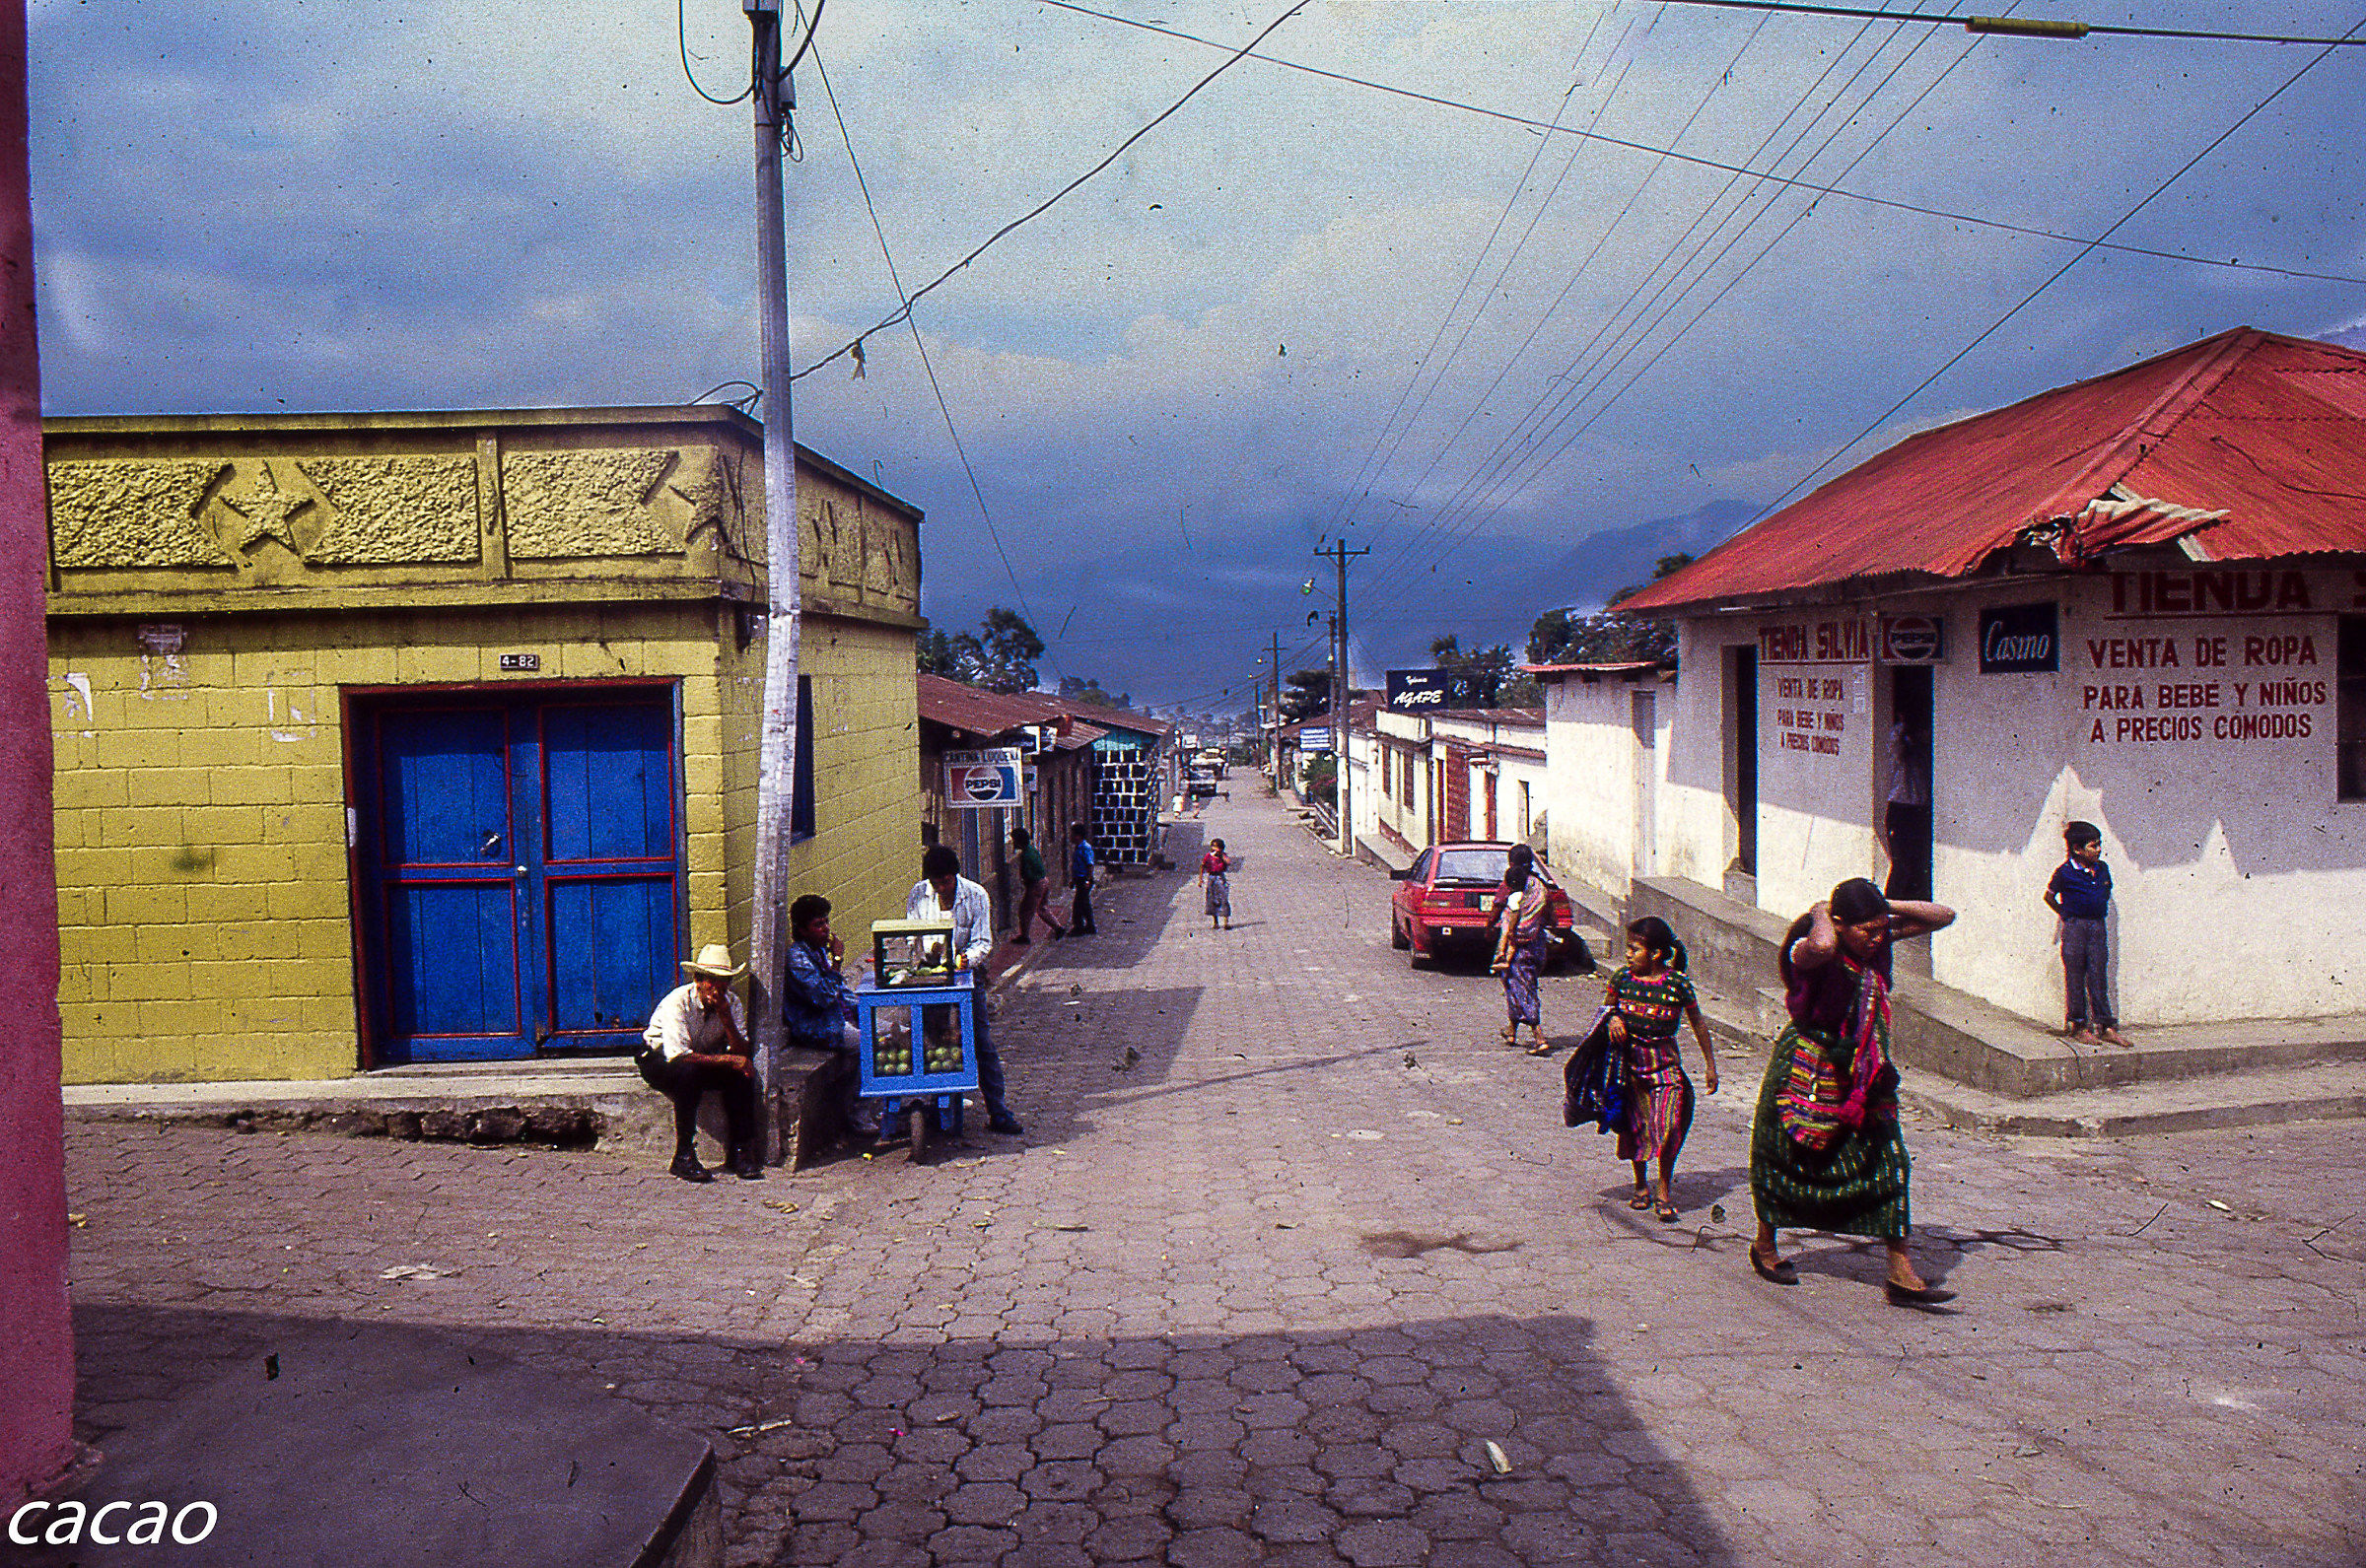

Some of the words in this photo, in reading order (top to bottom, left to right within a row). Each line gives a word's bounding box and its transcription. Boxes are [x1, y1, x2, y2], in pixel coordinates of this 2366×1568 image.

[1815, 620, 1869, 659] SILVIA
[2087, 638, 2180, 668] VENTA
[2194, 637, 2227, 667] DE
[2244, 636, 2317, 666] ROPA
[502, 655, 534, 667] 4-82
[2083, 684, 2145, 710] PARA
[2233, 682, 2250, 707] Y
[2259, 677, 2327, 707] NIÑOS
[2089, 717, 2106, 743] A
[2116, 716, 2203, 742] PRECIOS
[965, 779, 1001, 788] PEPSI
